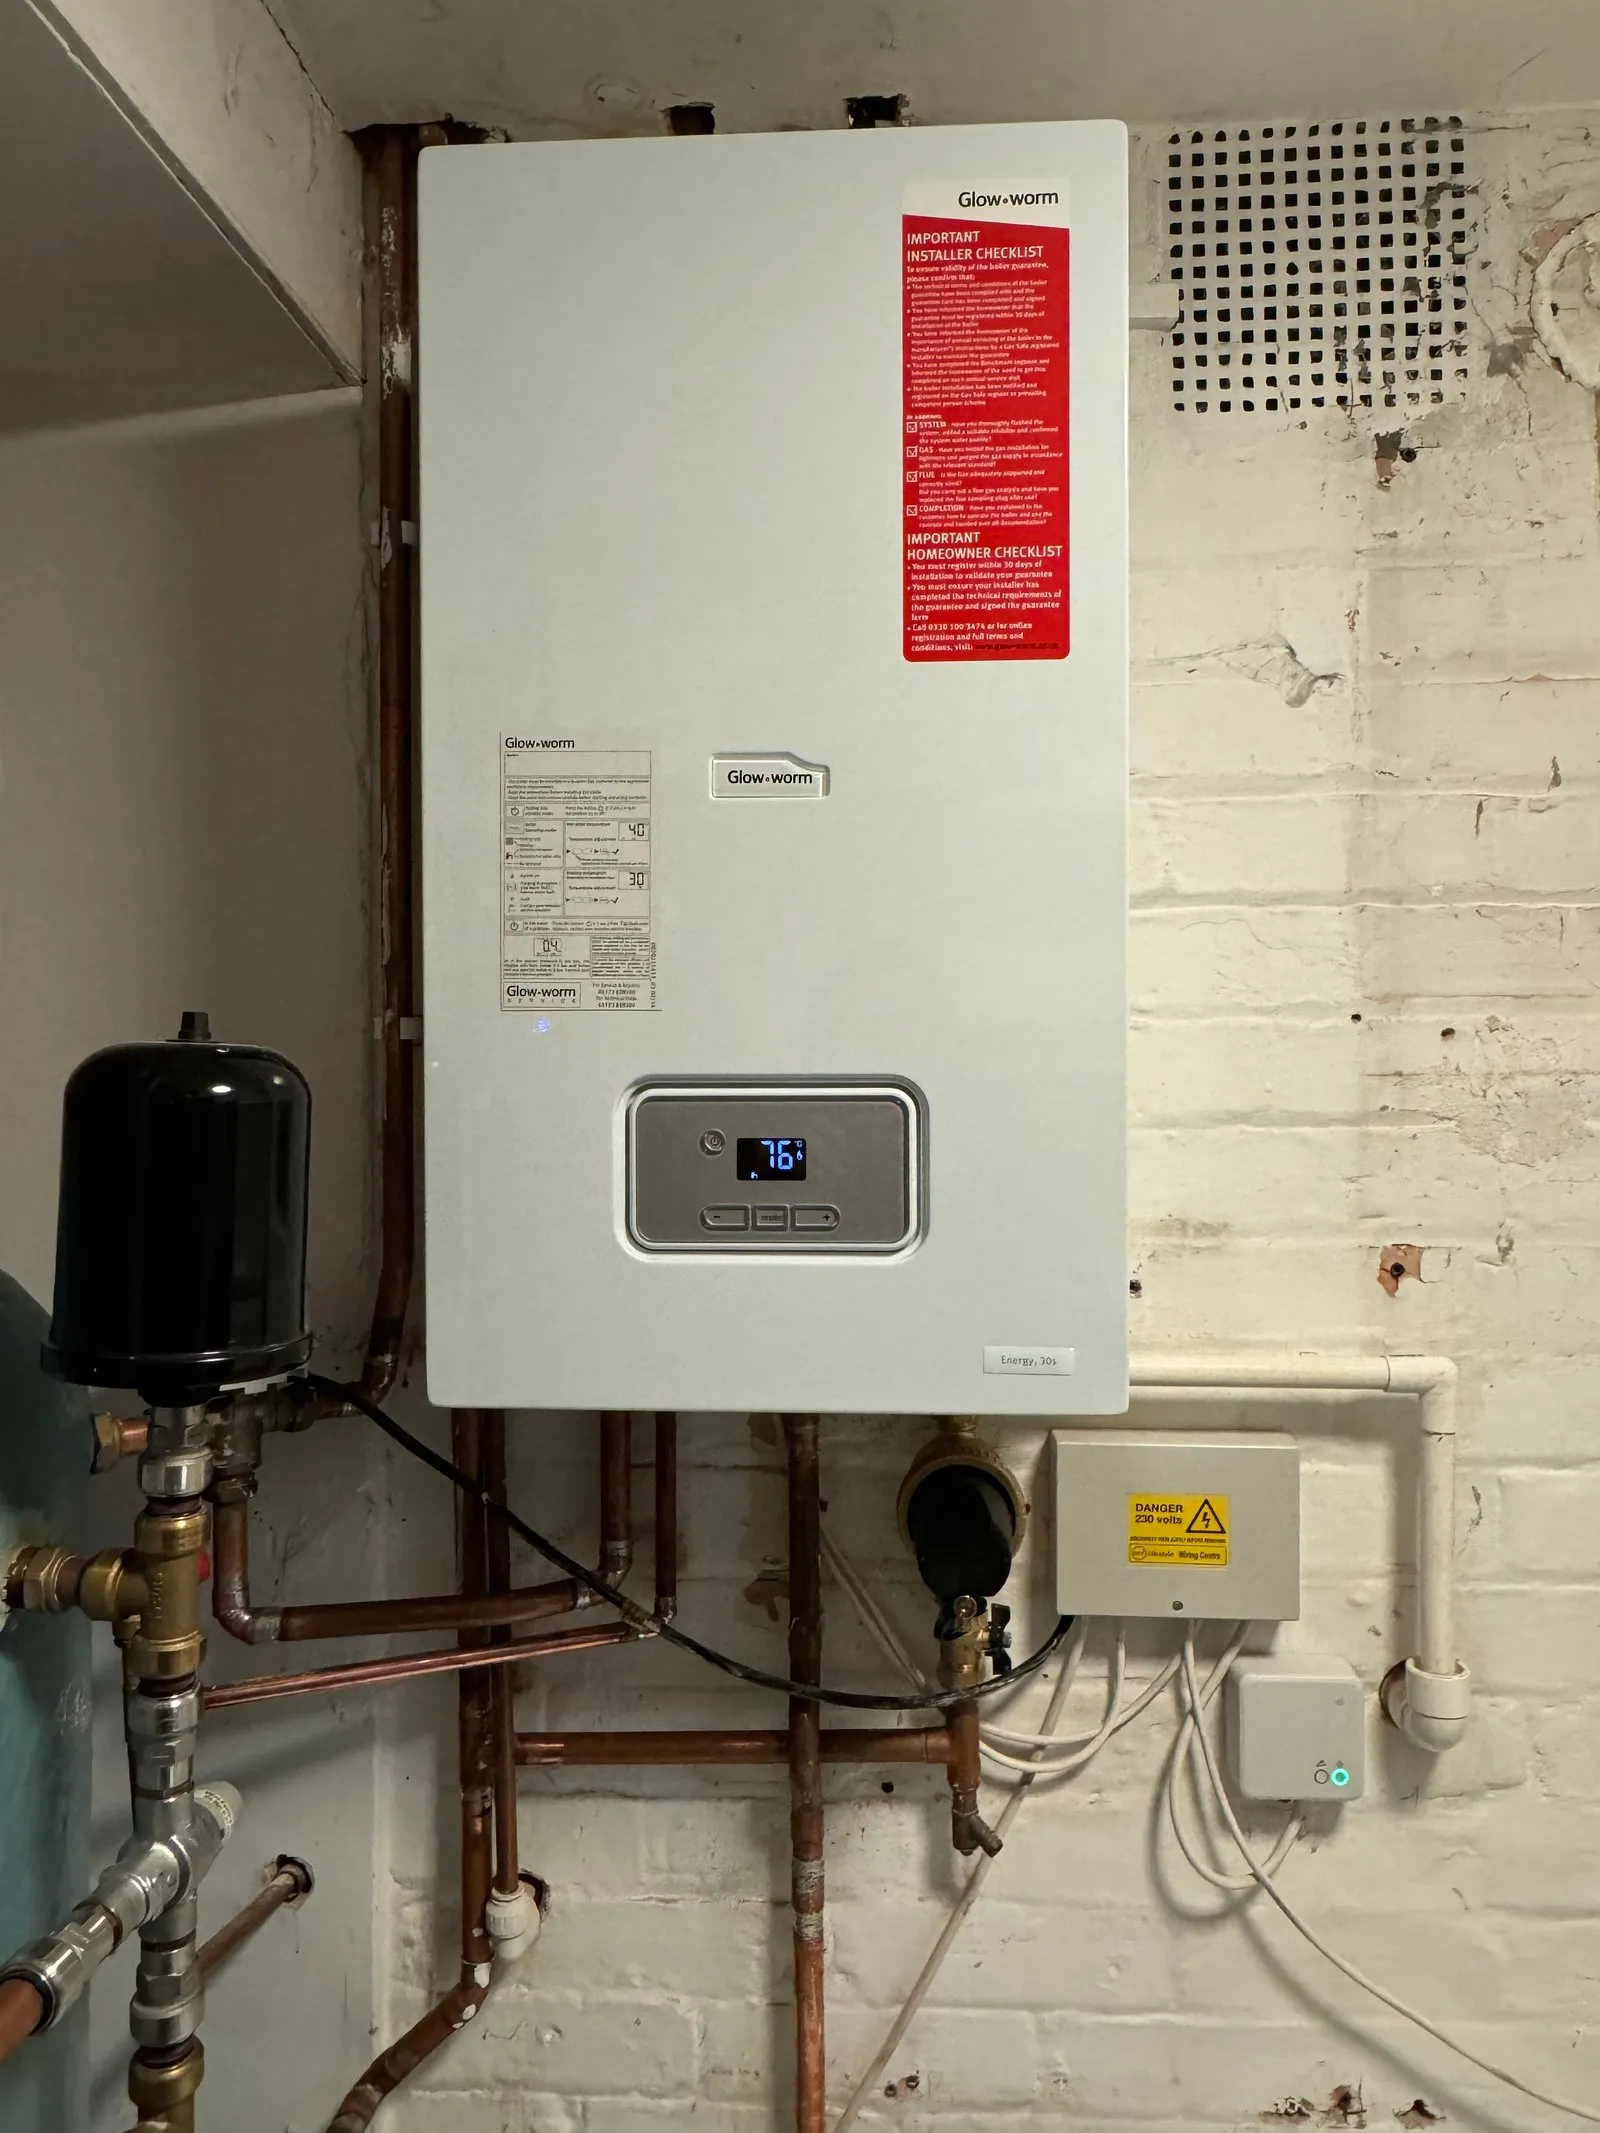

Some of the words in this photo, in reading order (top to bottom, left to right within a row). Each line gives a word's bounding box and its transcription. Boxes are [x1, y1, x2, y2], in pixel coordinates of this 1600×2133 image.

[907, 231, 981, 245] IMPORTANT
[907, 249, 973, 262] INSTALLER
[975, 246, 1044, 260] CHECKLIST
[907, 532, 980, 545] IMPORTANT
[907, 549, 991, 561] HOMEOWNER
[994, 545, 1063, 558] CHECKLIST
[947, 562, 977, 571] register
[1015, 561, 1033, 570] days
[974, 583, 992, 591] your
[629, 872, 644, 886] 30
[760, 1140, 794, 1170] 76
[1136, 1504, 1183, 1512] DANGER
[1135, 1514, 1154, 1523] 230
[1156, 1516, 1182, 1524] volts
